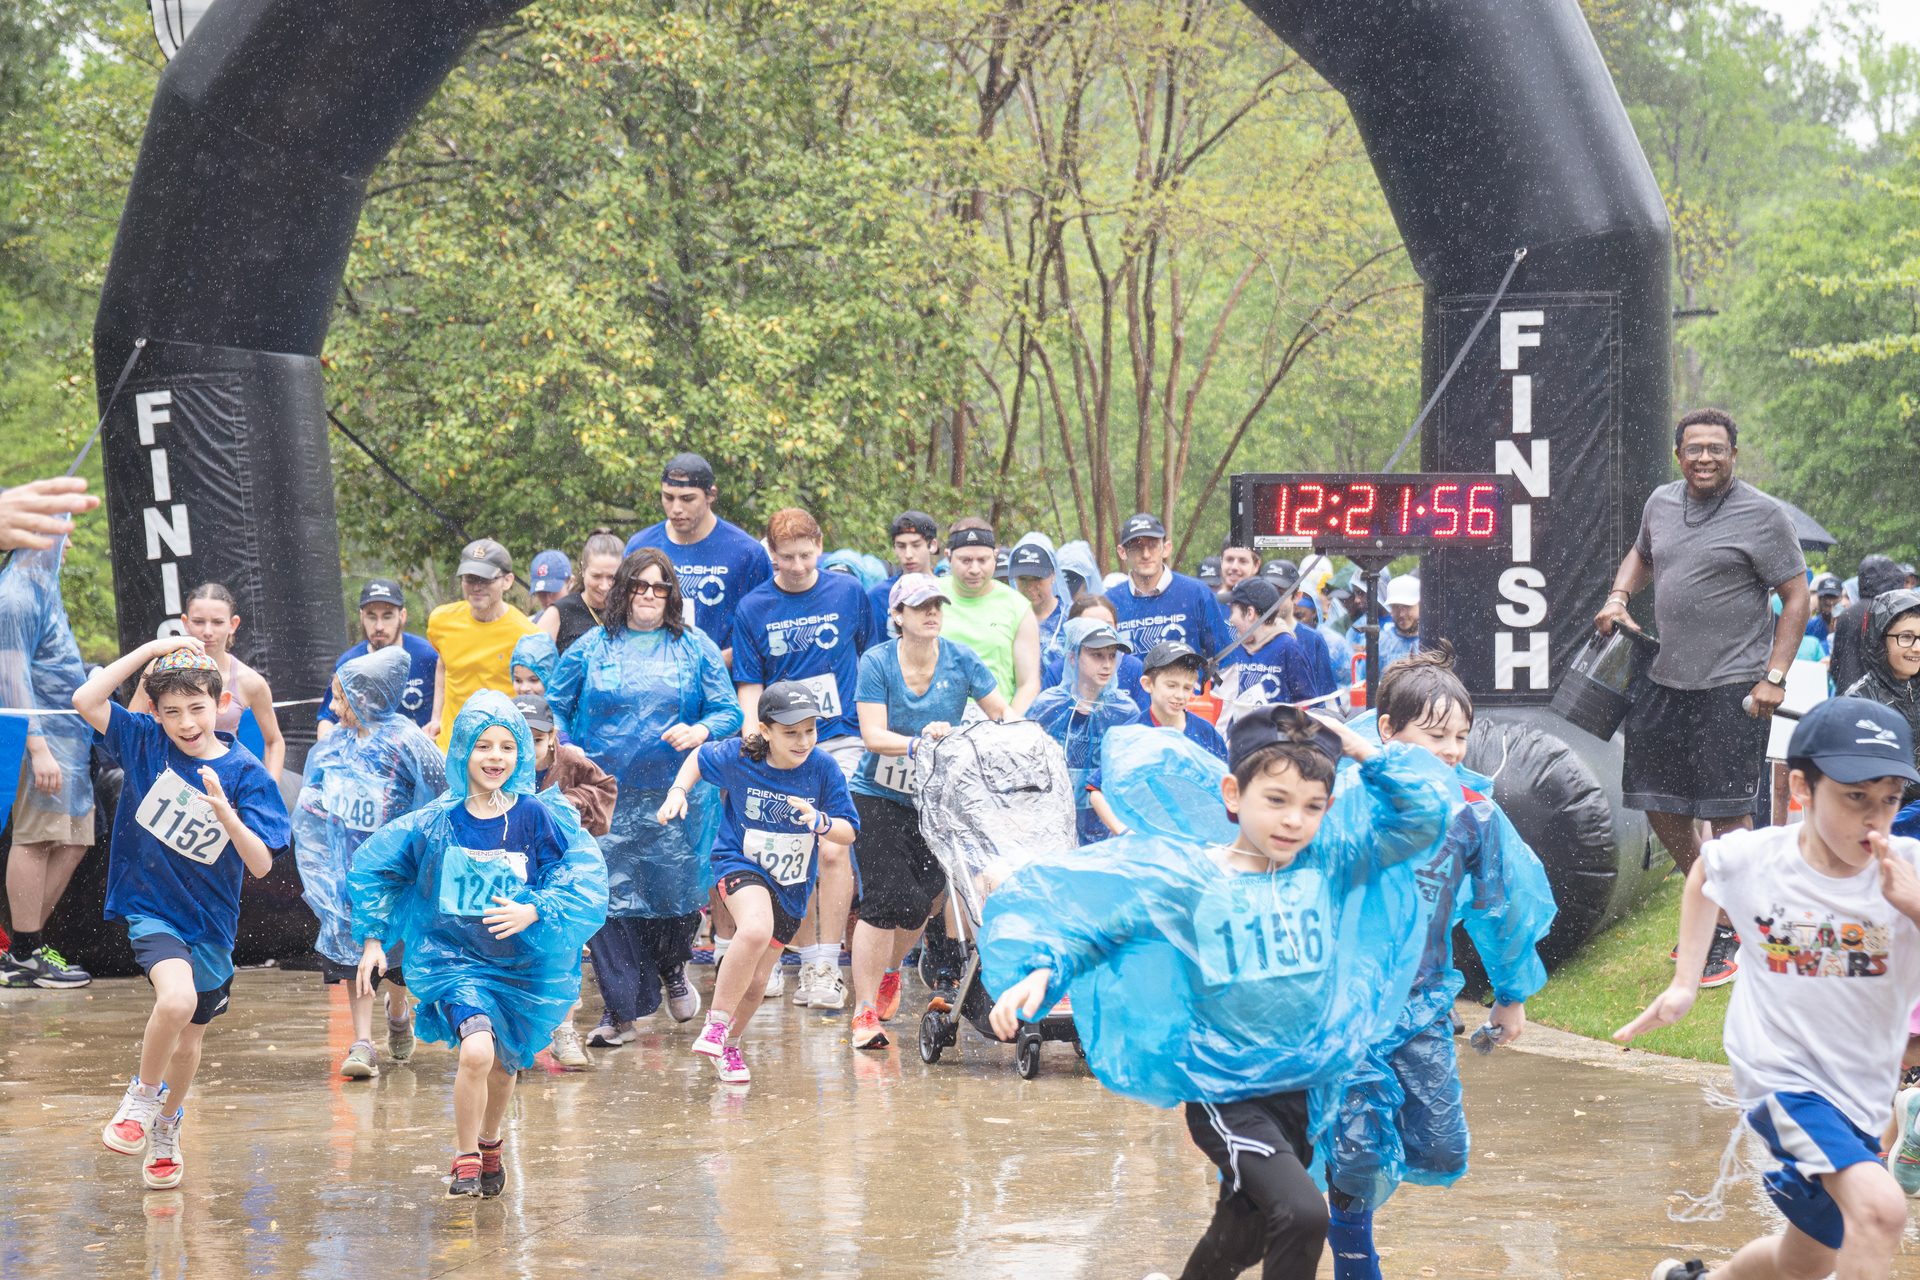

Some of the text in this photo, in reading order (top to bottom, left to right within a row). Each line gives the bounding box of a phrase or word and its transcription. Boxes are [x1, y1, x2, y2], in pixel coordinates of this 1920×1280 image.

[136, 390, 192, 640] FINI
[1494, 311, 1549, 690] FINISH
[766, 613, 839, 632] FRIENDSHIP
[747, 787, 816, 804] FRIENDIP
[148, 797, 221, 859] 1152
[1214, 908, 1323, 975] 1156
